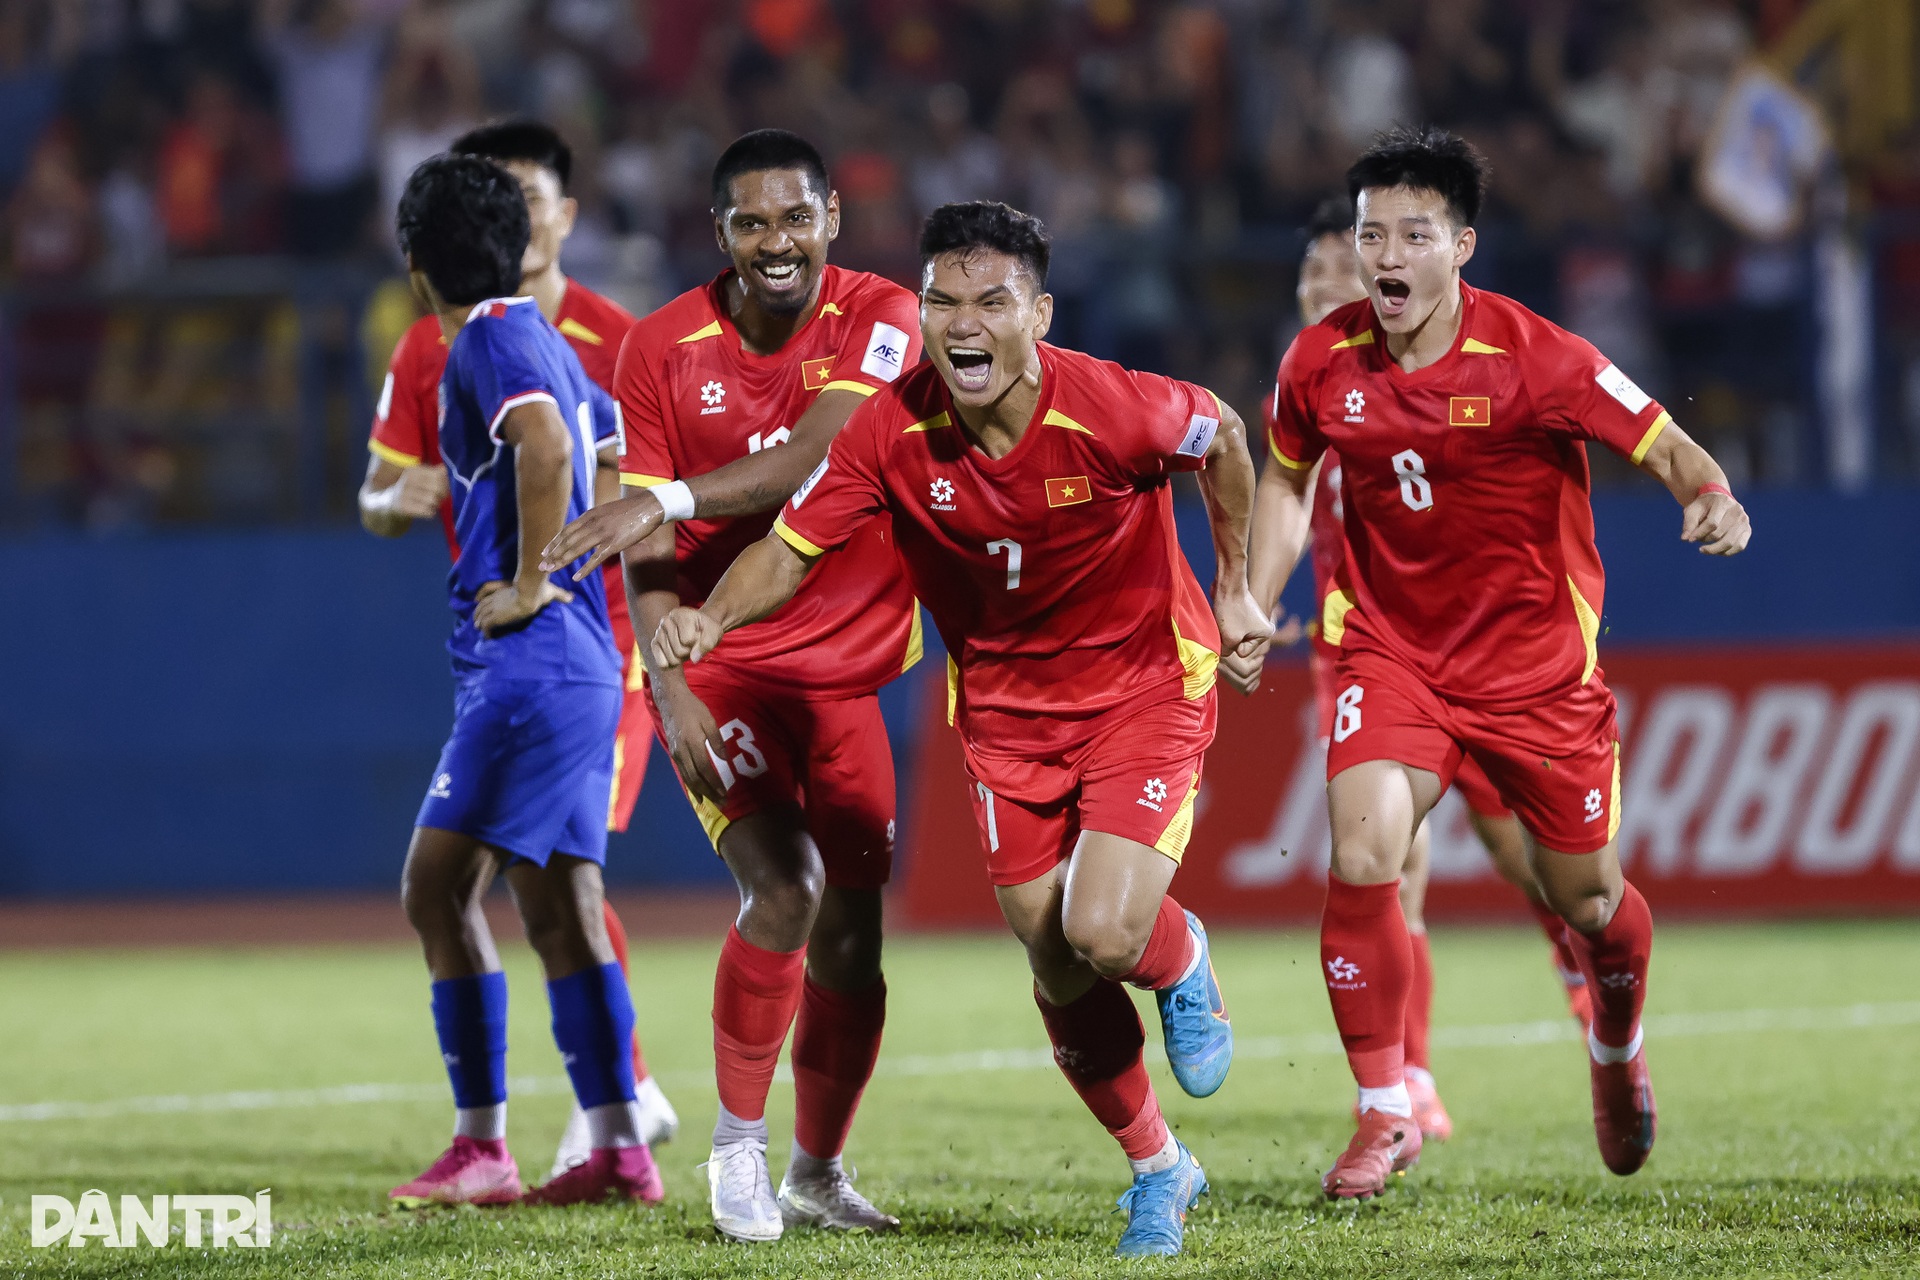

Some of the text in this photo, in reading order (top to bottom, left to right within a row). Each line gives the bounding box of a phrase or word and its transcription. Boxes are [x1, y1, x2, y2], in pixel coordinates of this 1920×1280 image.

[873, 344, 899, 363] AFC
[1191, 421, 1207, 451] AFC
[1391, 448, 1434, 511] 8
[986, 537, 1022, 590] 7
[1334, 684, 1364, 743] 8
[705, 717, 769, 791] 13
[976, 781, 999, 854] 7
